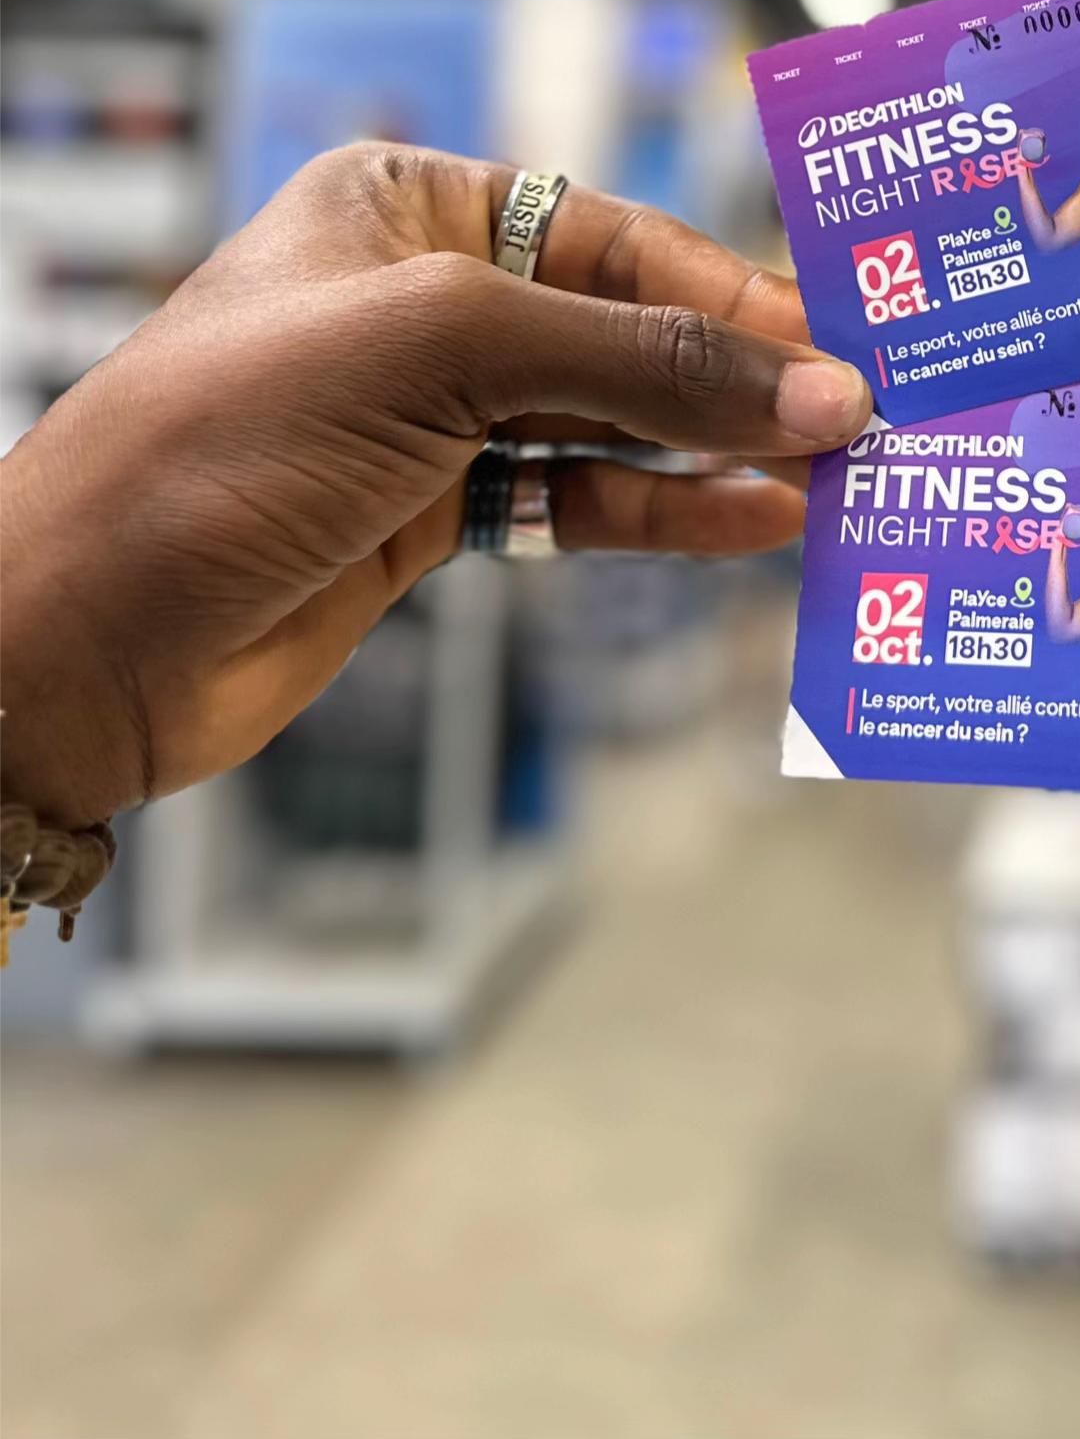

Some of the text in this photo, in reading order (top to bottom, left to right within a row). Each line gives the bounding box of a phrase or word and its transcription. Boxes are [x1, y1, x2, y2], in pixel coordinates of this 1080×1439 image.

[773, 67, 801, 82] TICKET
[834, 50, 863, 65] TICKET
[896, 33, 925, 48] TICKET
[958, 16, 988, 31] TICKET
[829, 81, 966, 137] DECATHLON
[803, 102, 1018, 195] FITNESS
[505, 181, 546, 252] JESUS
[815, 173, 923, 228] NIGHT
[856, 239, 921, 299] 02
[942, 238, 1023, 270] Palmeraie
[950, 259, 1024, 296] 18h30
[865, 281, 942, 325] oct.
[886, 345, 909, 362] Le
[910, 331, 962, 358] sport,
[961, 318, 1008, 343] votre
[1009, 308, 1043, 331] allié
[892, 368, 909, 386] le
[909, 354, 969, 381] cancer
[971, 347, 996, 366] du
[996, 337, 1034, 360] sein
[883, 434, 1024, 458] DECATHLON
[843, 464, 1068, 514] FITNESS
[839, 514, 957, 547] NIGHT
[856, 579, 924, 636] 02
[948, 610, 1035, 630] Palmeraie
[853, 630, 933, 666] oct.
[949, 635, 1028, 661] 18h30
[862, 688, 883, 708] Le
[886, 692, 941, 714] sport,
[944, 695, 993, 713] votre
[995, 695, 1032, 715] allié
[859, 716, 875, 735] le
[877, 722, 944, 739] cancer
[946, 720, 971, 741] du
[973, 723, 1014, 743] sein
